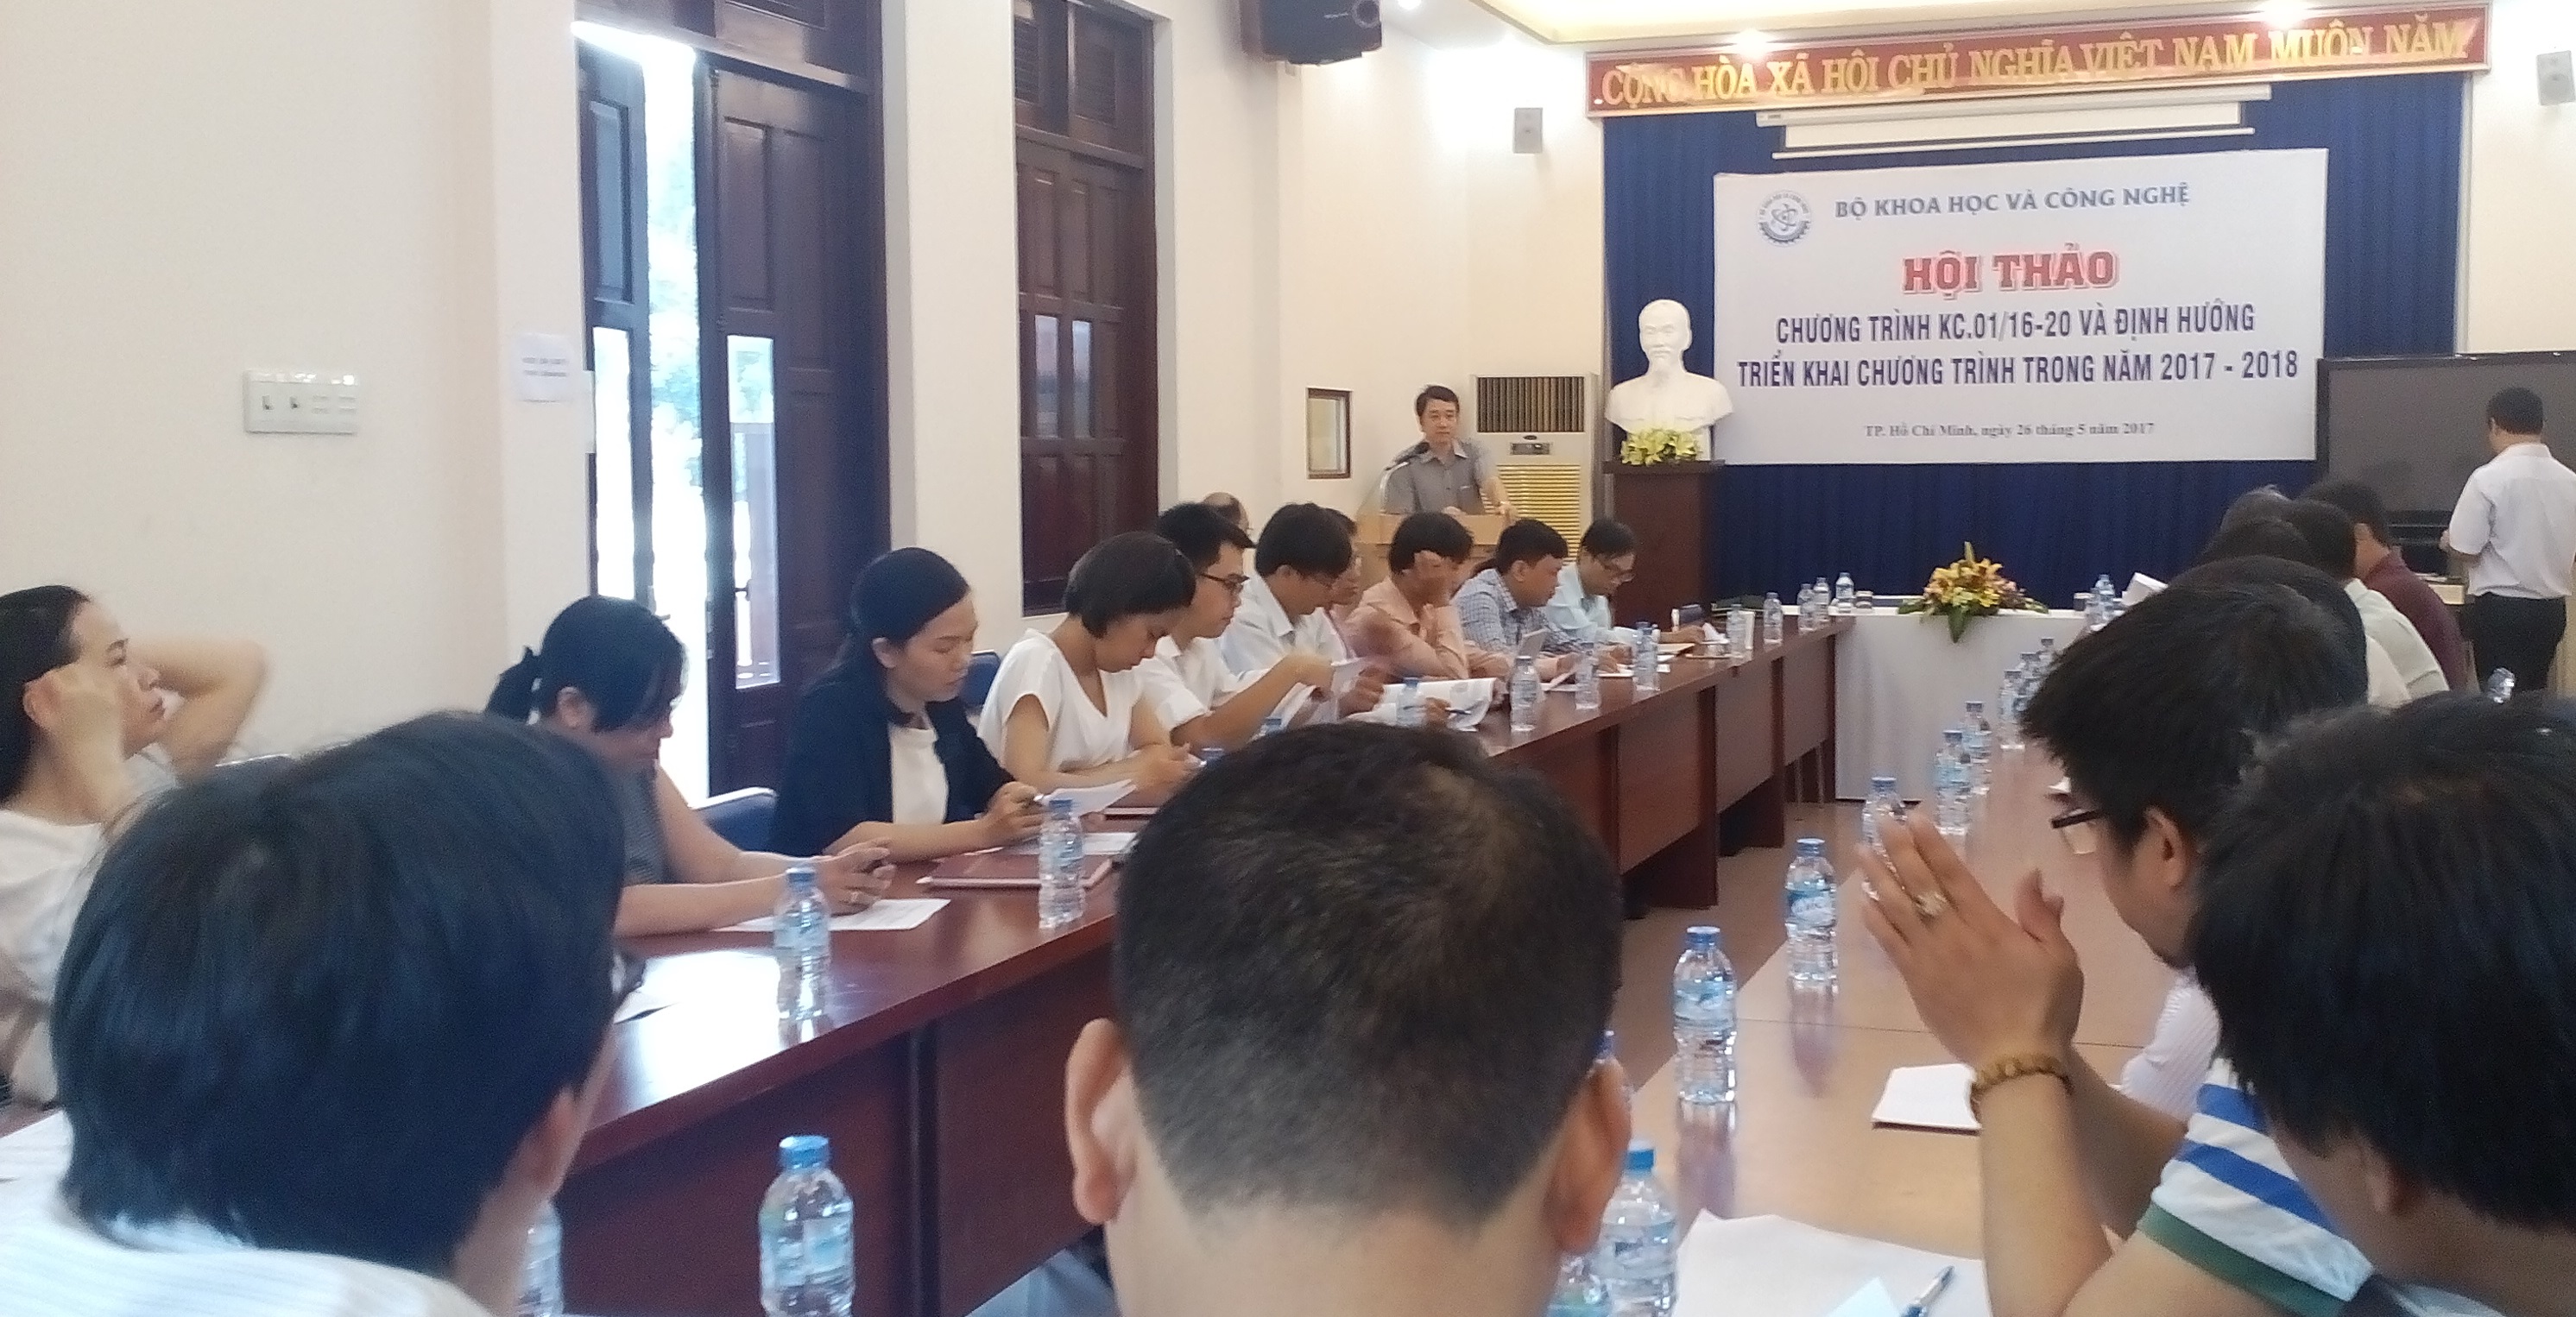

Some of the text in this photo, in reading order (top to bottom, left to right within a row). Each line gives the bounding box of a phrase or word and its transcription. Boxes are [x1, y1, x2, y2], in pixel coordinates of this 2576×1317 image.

[1691, 55, 1757, 99] HÒA
[1766, 53, 1814, 97] XÃ
[1887, 42, 1960, 89] CHỦ
[1968, 38, 2074, 85] NGHĨA
[2172, 32, 2258, 71] NAM
[2268, 18, 2375, 62] MUÔN
[2383, 13, 2482, 59] NĂM
[1835, 197, 1866, 220] BỘ
[1875, 197, 1941, 217] KHOA
[1948, 194, 1999, 216] HỌC
[2006, 189, 2037, 210] VÀ
[2044, 187, 2116, 210] CÔNG
[2123, 182, 2190, 207] NGHỆ
[1903, 243, 2121, 300] HỘI THẢO
[1777, 313, 1861, 344] CHƯƠNG
[1868, 309, 1933, 342] TRÌNH
[1939, 308, 2072, 343] KC.01/16-20
[2079, 302, 2107, 336] VÀ
[2115, 306, 2169, 342] ĐỊNH
[1738, 350, 1796, 388] TRIỂN
[1803, 359, 1850, 388] KHAI
[1856, 355, 1944, 387] CHƯƠNG
[1951, 350, 2016, 385] TRÌNH
[2023, 354, 2096, 383] TRONG
[2103, 348, 2153, 382] NĂM
[2160, 351, 2216, 381] 2017
[2241, 350, 2299, 380] 2018
[1866, 425, 1886, 437] TP.
